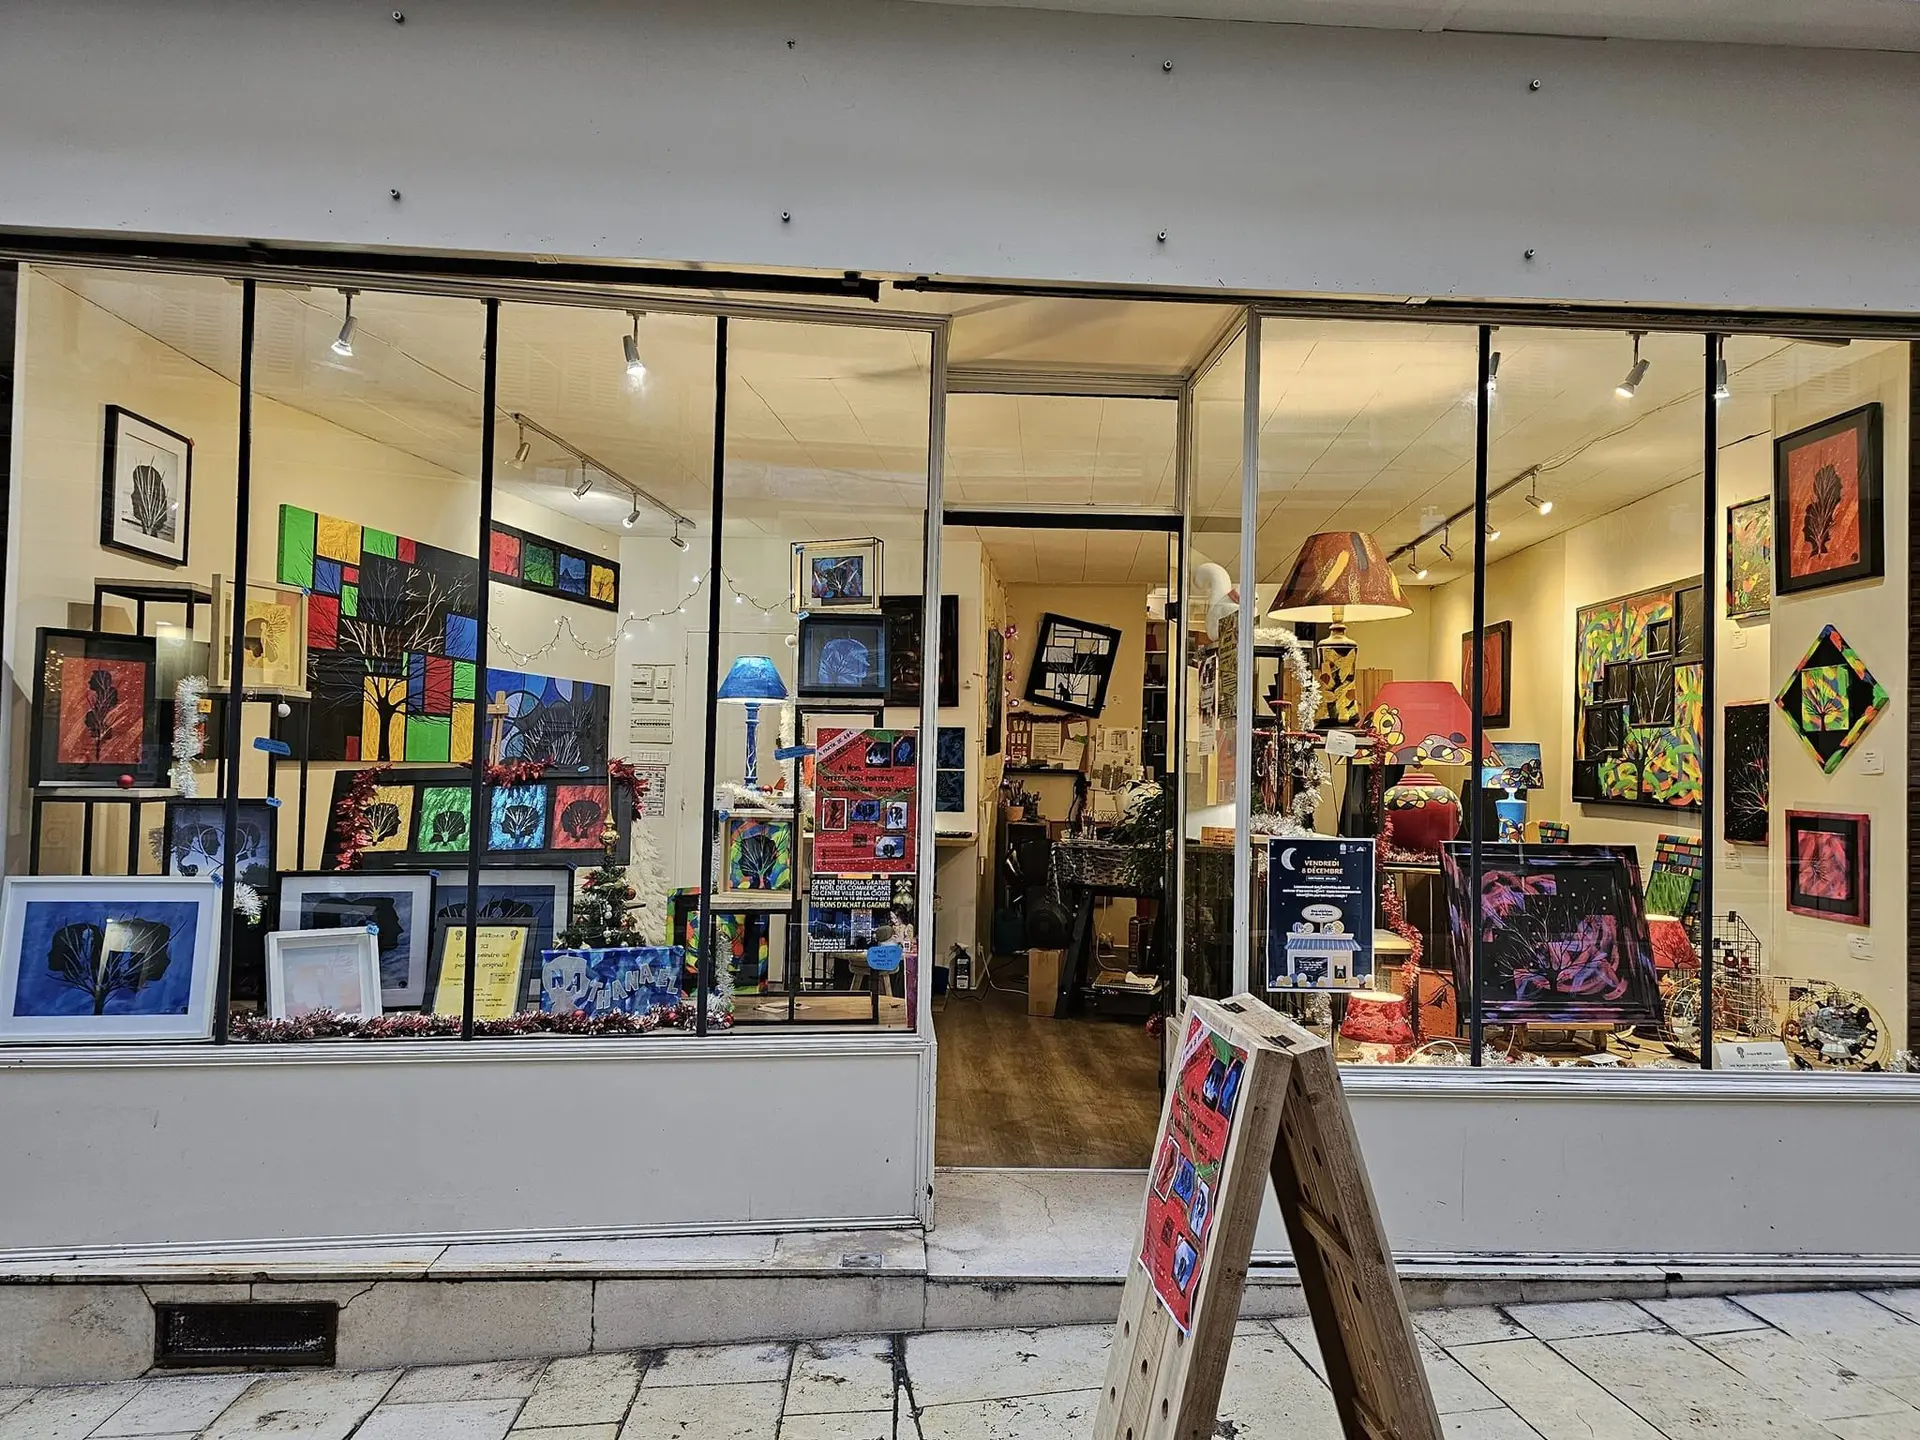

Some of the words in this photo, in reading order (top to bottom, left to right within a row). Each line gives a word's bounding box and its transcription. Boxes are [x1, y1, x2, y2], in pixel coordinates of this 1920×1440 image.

[1307, 866, 1344, 875] DÉCEMBRE
[866, 901, 891, 909] GAGNER
[551, 963, 679, 1010] NATHANAEL
